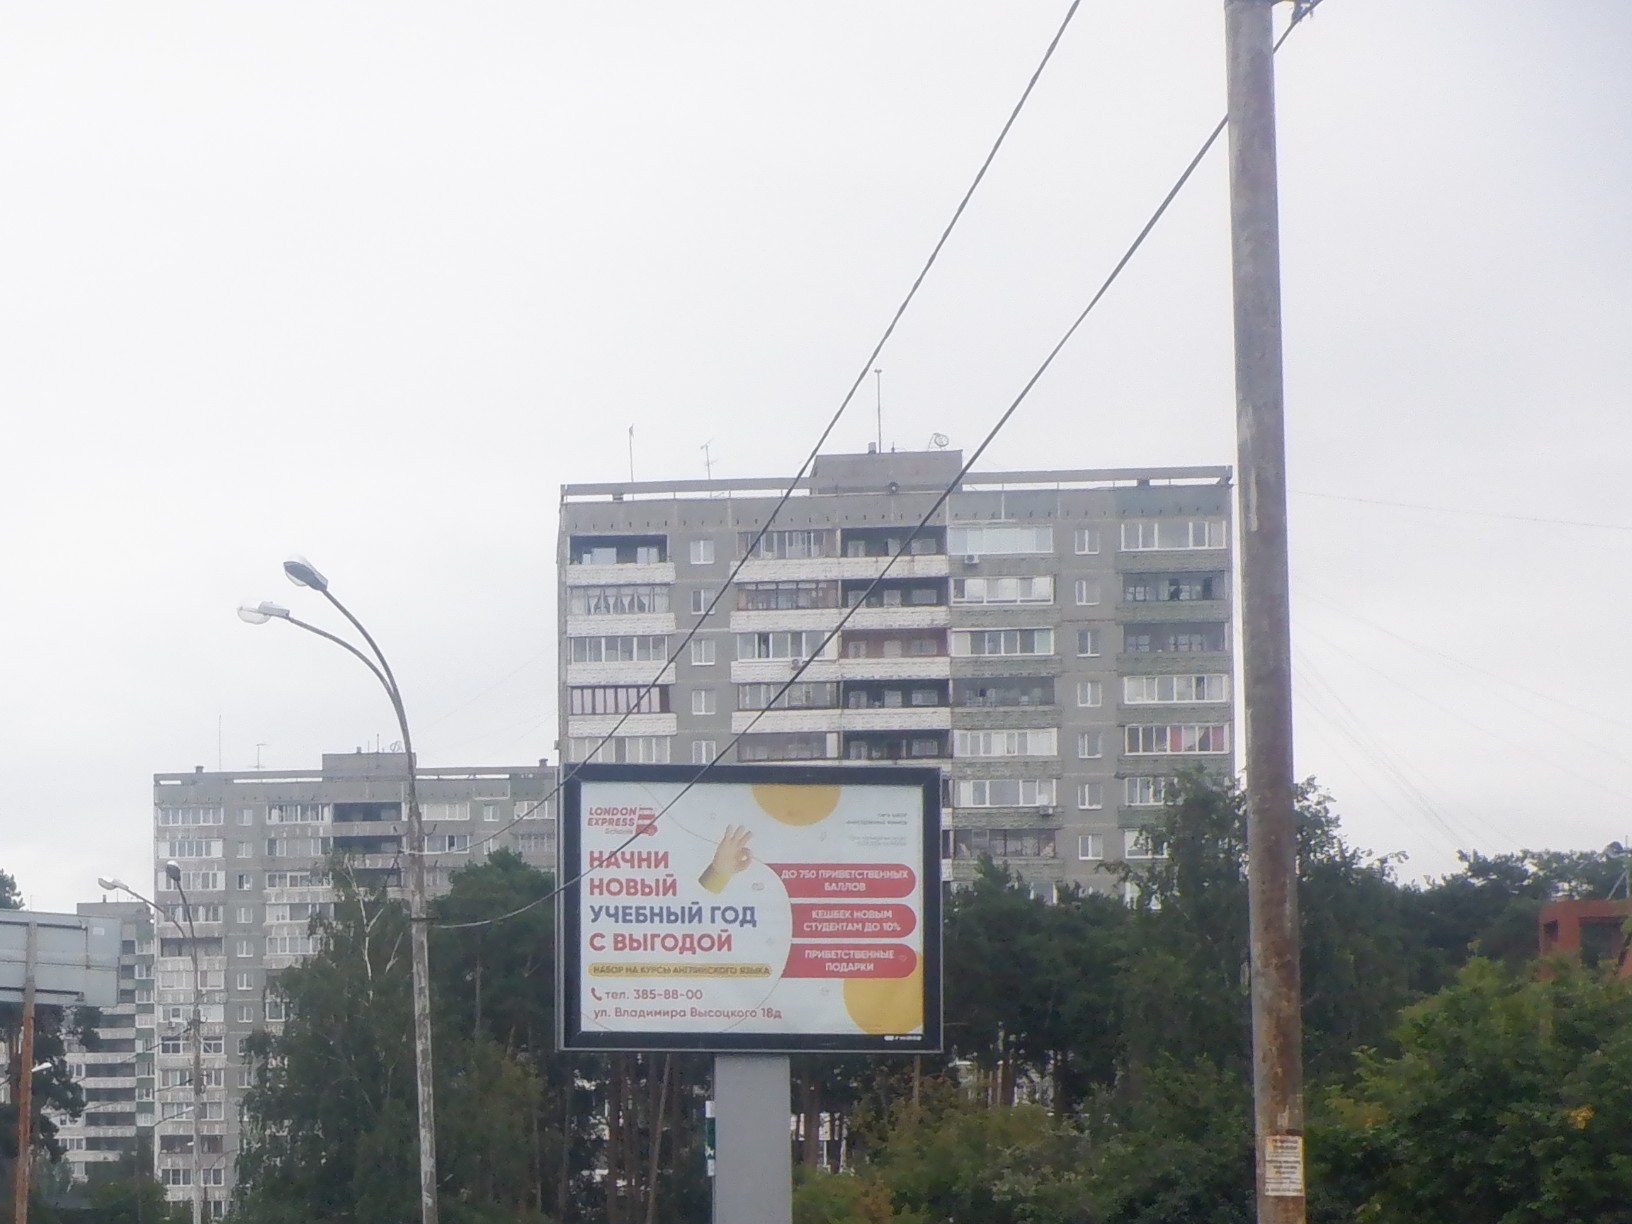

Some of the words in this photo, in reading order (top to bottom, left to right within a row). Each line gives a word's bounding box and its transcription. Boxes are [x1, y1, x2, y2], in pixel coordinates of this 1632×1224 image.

[589, 807, 637, 816] LONDON
[587, 817, 635, 827] EXPRESS
[589, 850, 670, 869] НАЧНИ
[781, 870, 797, 879] ДО
[799, 870, 817, 879] 750
[819, 870, 908, 879] ПРИВЕТСТВЕННЫХ
[589, 873, 678, 897] НОВЫЙ
[824, 882, 866, 891] БАЛЛОВ
[589, 901, 703, 924] УЧЕБНЫЙ
[710, 906, 756, 928] ГОД
[812, 910, 851, 918] КЕШБЕК
[854, 910, 892, 918] НОВЫМ
[804, 923, 862, 932] СТУДЕНТАМ
[864, 923, 880, 932] ДО
[589, 932, 606, 952] С
[613, 929, 733, 955] ВЫГОДОЙ
[805, 950, 895, 959] ПРИВЕТСТВЕННЫЕ
[593, 966, 623, 974] НАБОР
[625, 966, 639, 974] НА
[640, 966, 671, 974] КУРСЫ
[825, 962, 874, 972] ПОДАРКИ
[605, 990, 629, 1000] тел.
[633, 989, 703, 1000] 385-88-00
[594, 1008, 611, 1019] ул.
[614, 1007, 686, 1019] Владимира
[690, 1007, 756, 1019] Высоцкого
[761, 1007, 782, 1019] 18д
